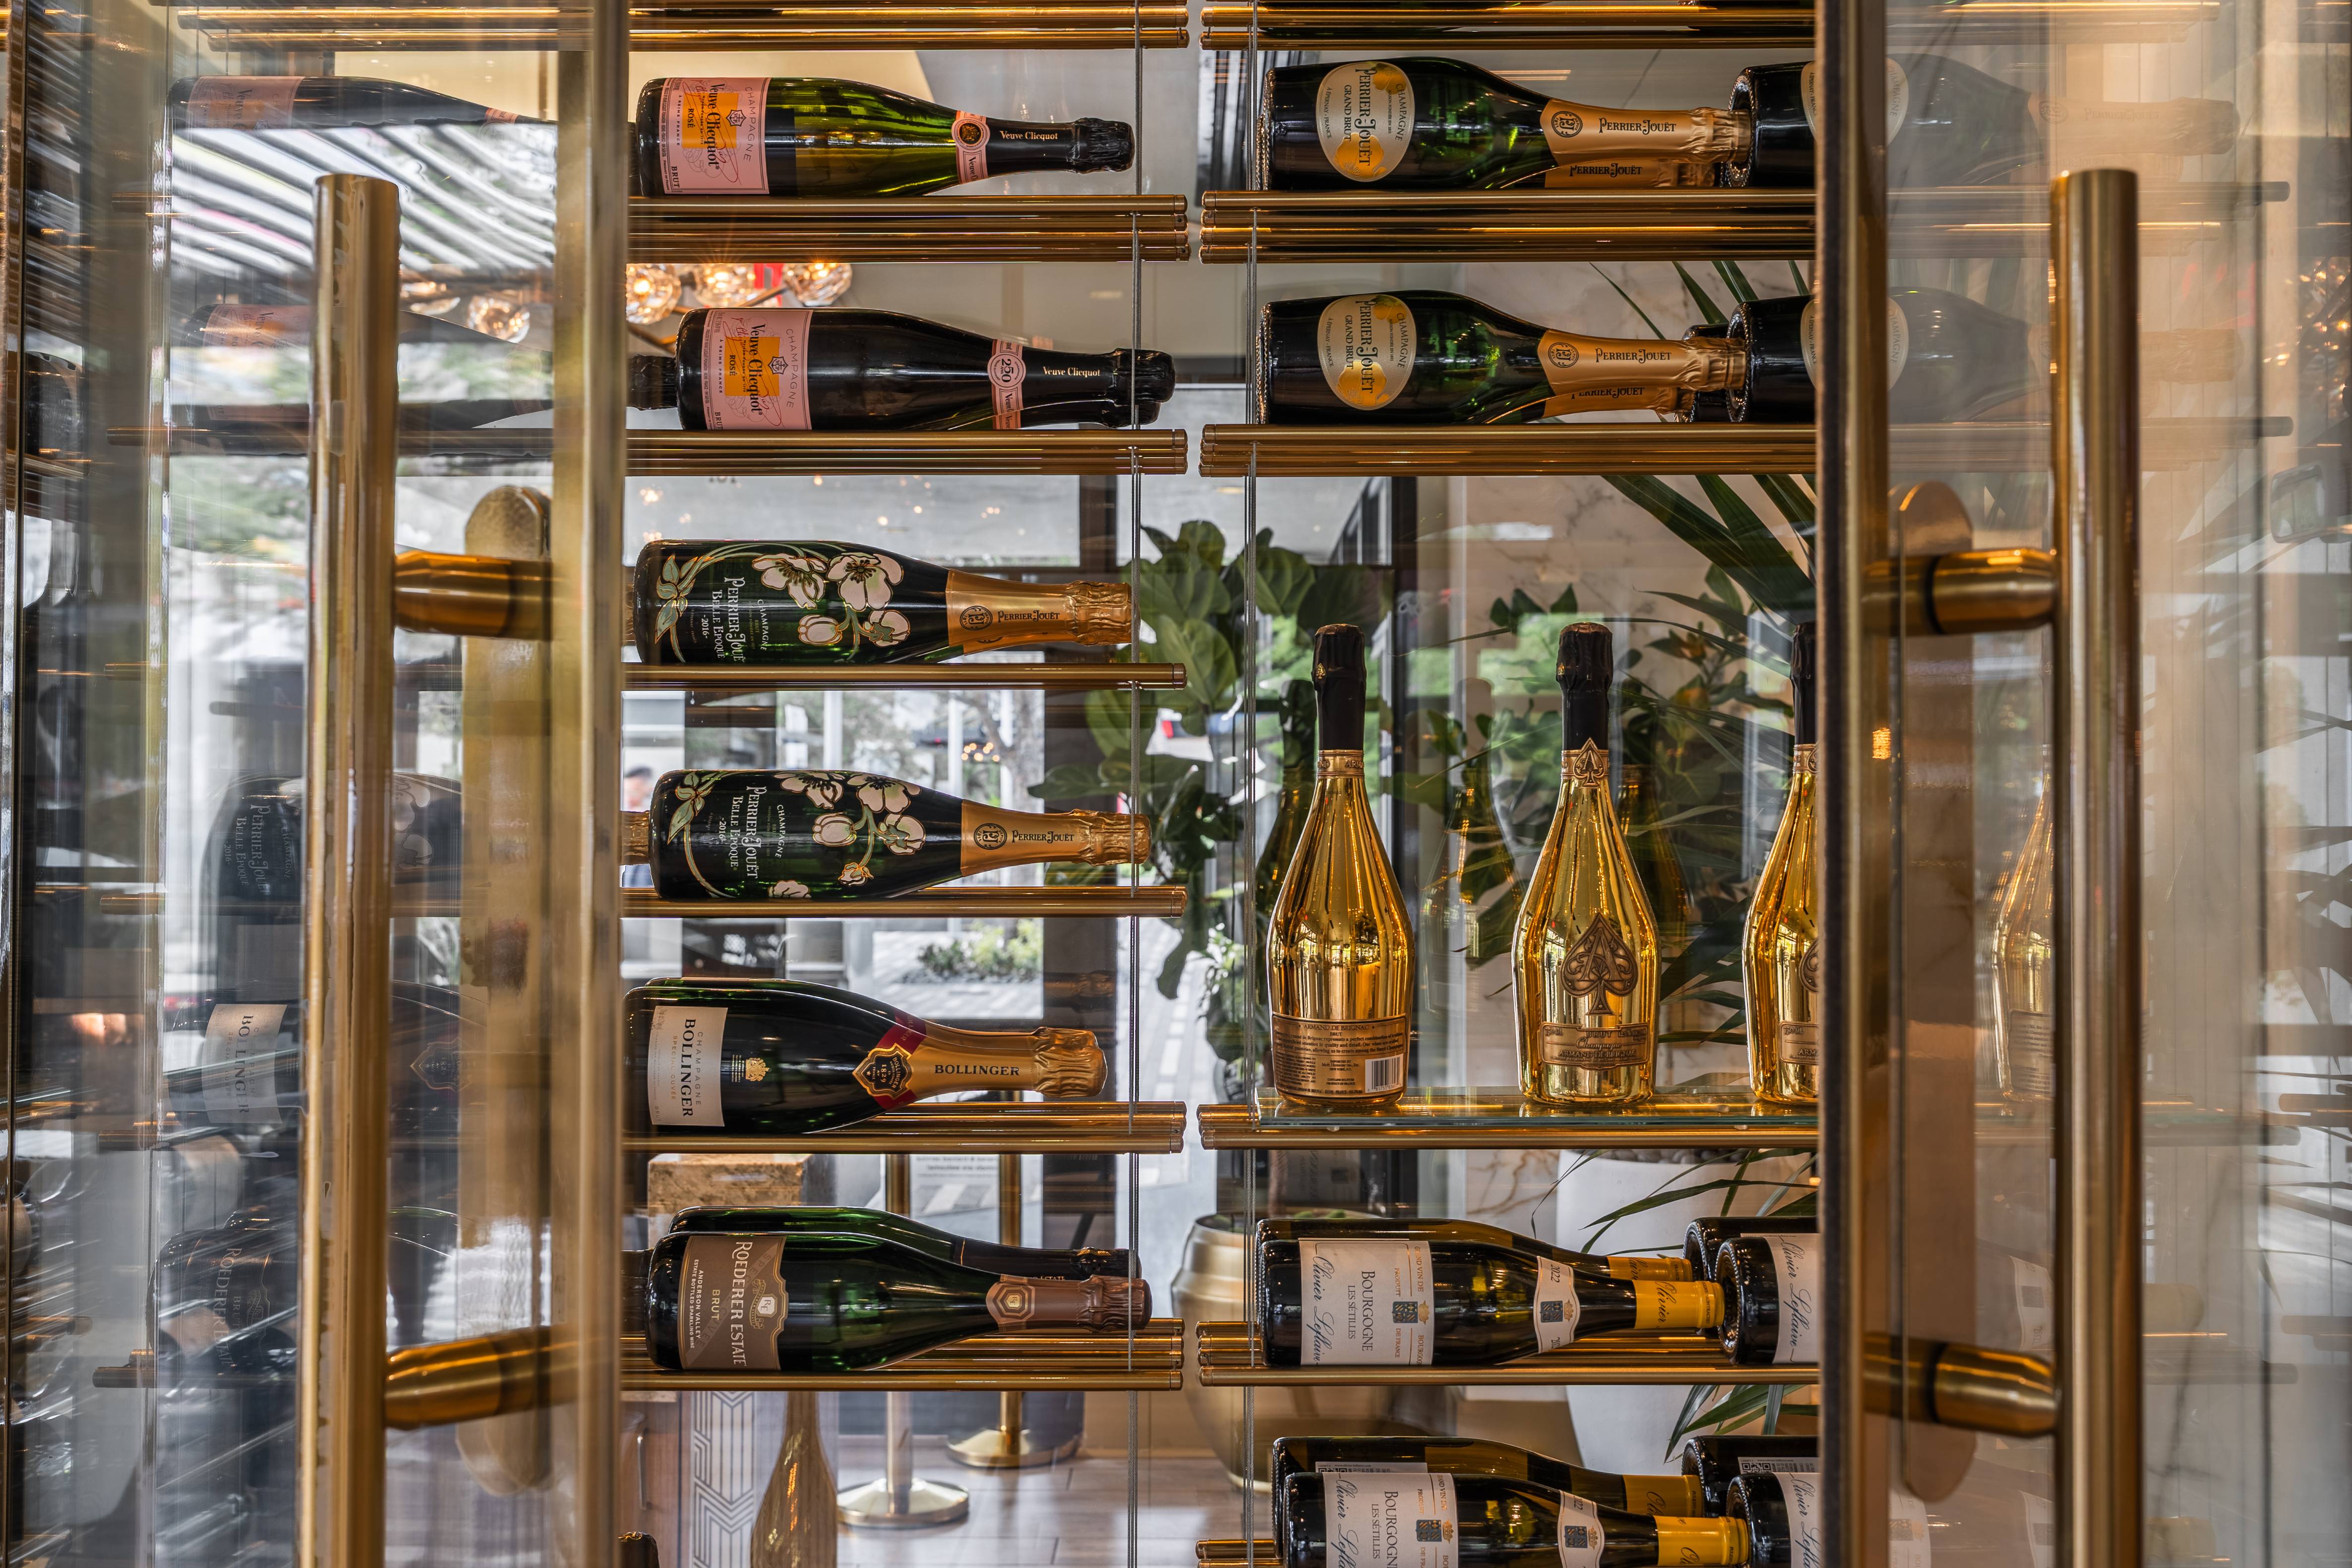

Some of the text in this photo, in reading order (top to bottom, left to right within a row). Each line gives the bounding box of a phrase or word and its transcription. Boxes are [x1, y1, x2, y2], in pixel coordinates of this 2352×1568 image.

[707, 83, 725, 109] Veuve
[1395, 83, 1407, 141] CHAMPAGNE
[743, 87, 756, 162] CHAMPAGNE
[1000, 130, 1058, 141] Veuve Clicquot
[1354, 68, 1377, 166] PERRIER-JOUËT
[1598, 117, 1677, 135] PERRIER-JOUËT
[750, 323, 766, 356] Veuve
[1345, 314, 1353, 344] GRAND
[1355, 301, 1378, 394] PERRIER-JOUËT
[1396, 312, 1409, 368] CHAMPAGNE
[786, 328, 798, 409] CHAMPAGNE
[1001, 358, 1014, 383] 250
[1043, 366, 1100, 378] Veuve Clicquot
[1595, 348, 1672, 363] PERRIER-JOUËT
[712, 590, 725, 658] BELLE EPOQUE
[724, 577, 746, 663] PERRIER-JOUË
[757, 599, 769, 651] CHAMPAGNE
[998, 609, 1060, 623] PERRIER-JOUËT
[728, 795, 744, 867] BELLE EPOQUE
[775, 804, 786, 858] CHAMPAGNE
[1012, 829, 1075, 844] PERRIER-JOUËT
[680, 1019, 696, 1117] BOLLINGER
[695, 1031, 703, 1105] CHAMPAGNE
[892, 1057, 901, 1088] BOLLINGER
[935, 1064, 1020, 1076] BOLLINGER
[695, 1270, 704, 1310] ANDERSON
[1313, 1256, 1335, 1302] Olivier
[1418, 1280, 1424, 1292] DE
[1551, 1264, 1561, 1283] 2022
[711, 1289, 721, 1321] BRUT
[730, 1241, 753, 1366] ROEDERER ESTATE
[1361, 1270, 1375, 1351] BOURGOGNE
[1781, 1242, 1812, 1347] Olivier Leflaive
[1348, 1301, 1358, 1339] SÉTILLES
[1336, 1479, 1358, 1519] Olivier
[1790, 1478, 1816, 1517] Olivier
[1372, 1519, 1381, 1559] SÉTILLES
